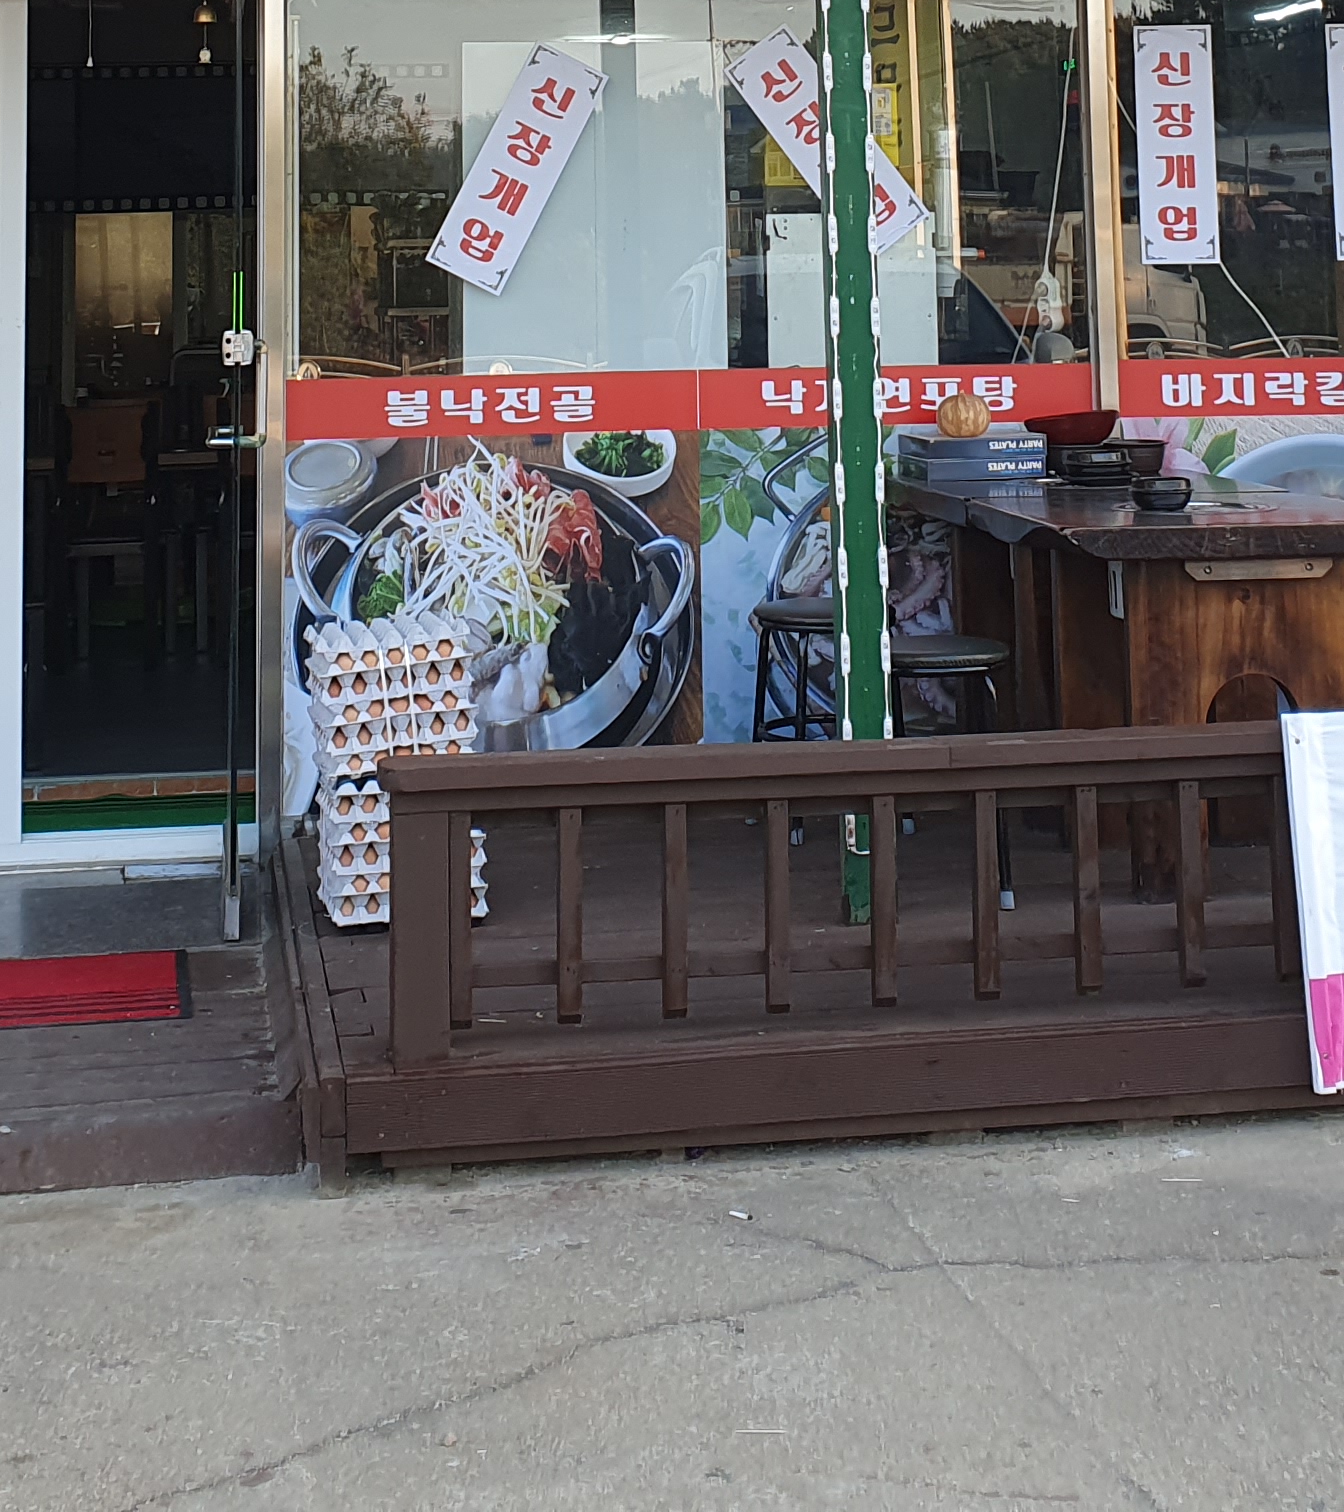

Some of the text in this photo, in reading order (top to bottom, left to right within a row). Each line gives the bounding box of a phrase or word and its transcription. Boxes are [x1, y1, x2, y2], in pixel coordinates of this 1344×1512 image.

[459, 78, 576, 264] 신장개업
[1151, 51, 1199, 243] 신장개업
[383, 384, 597, 428] 불낙전골
